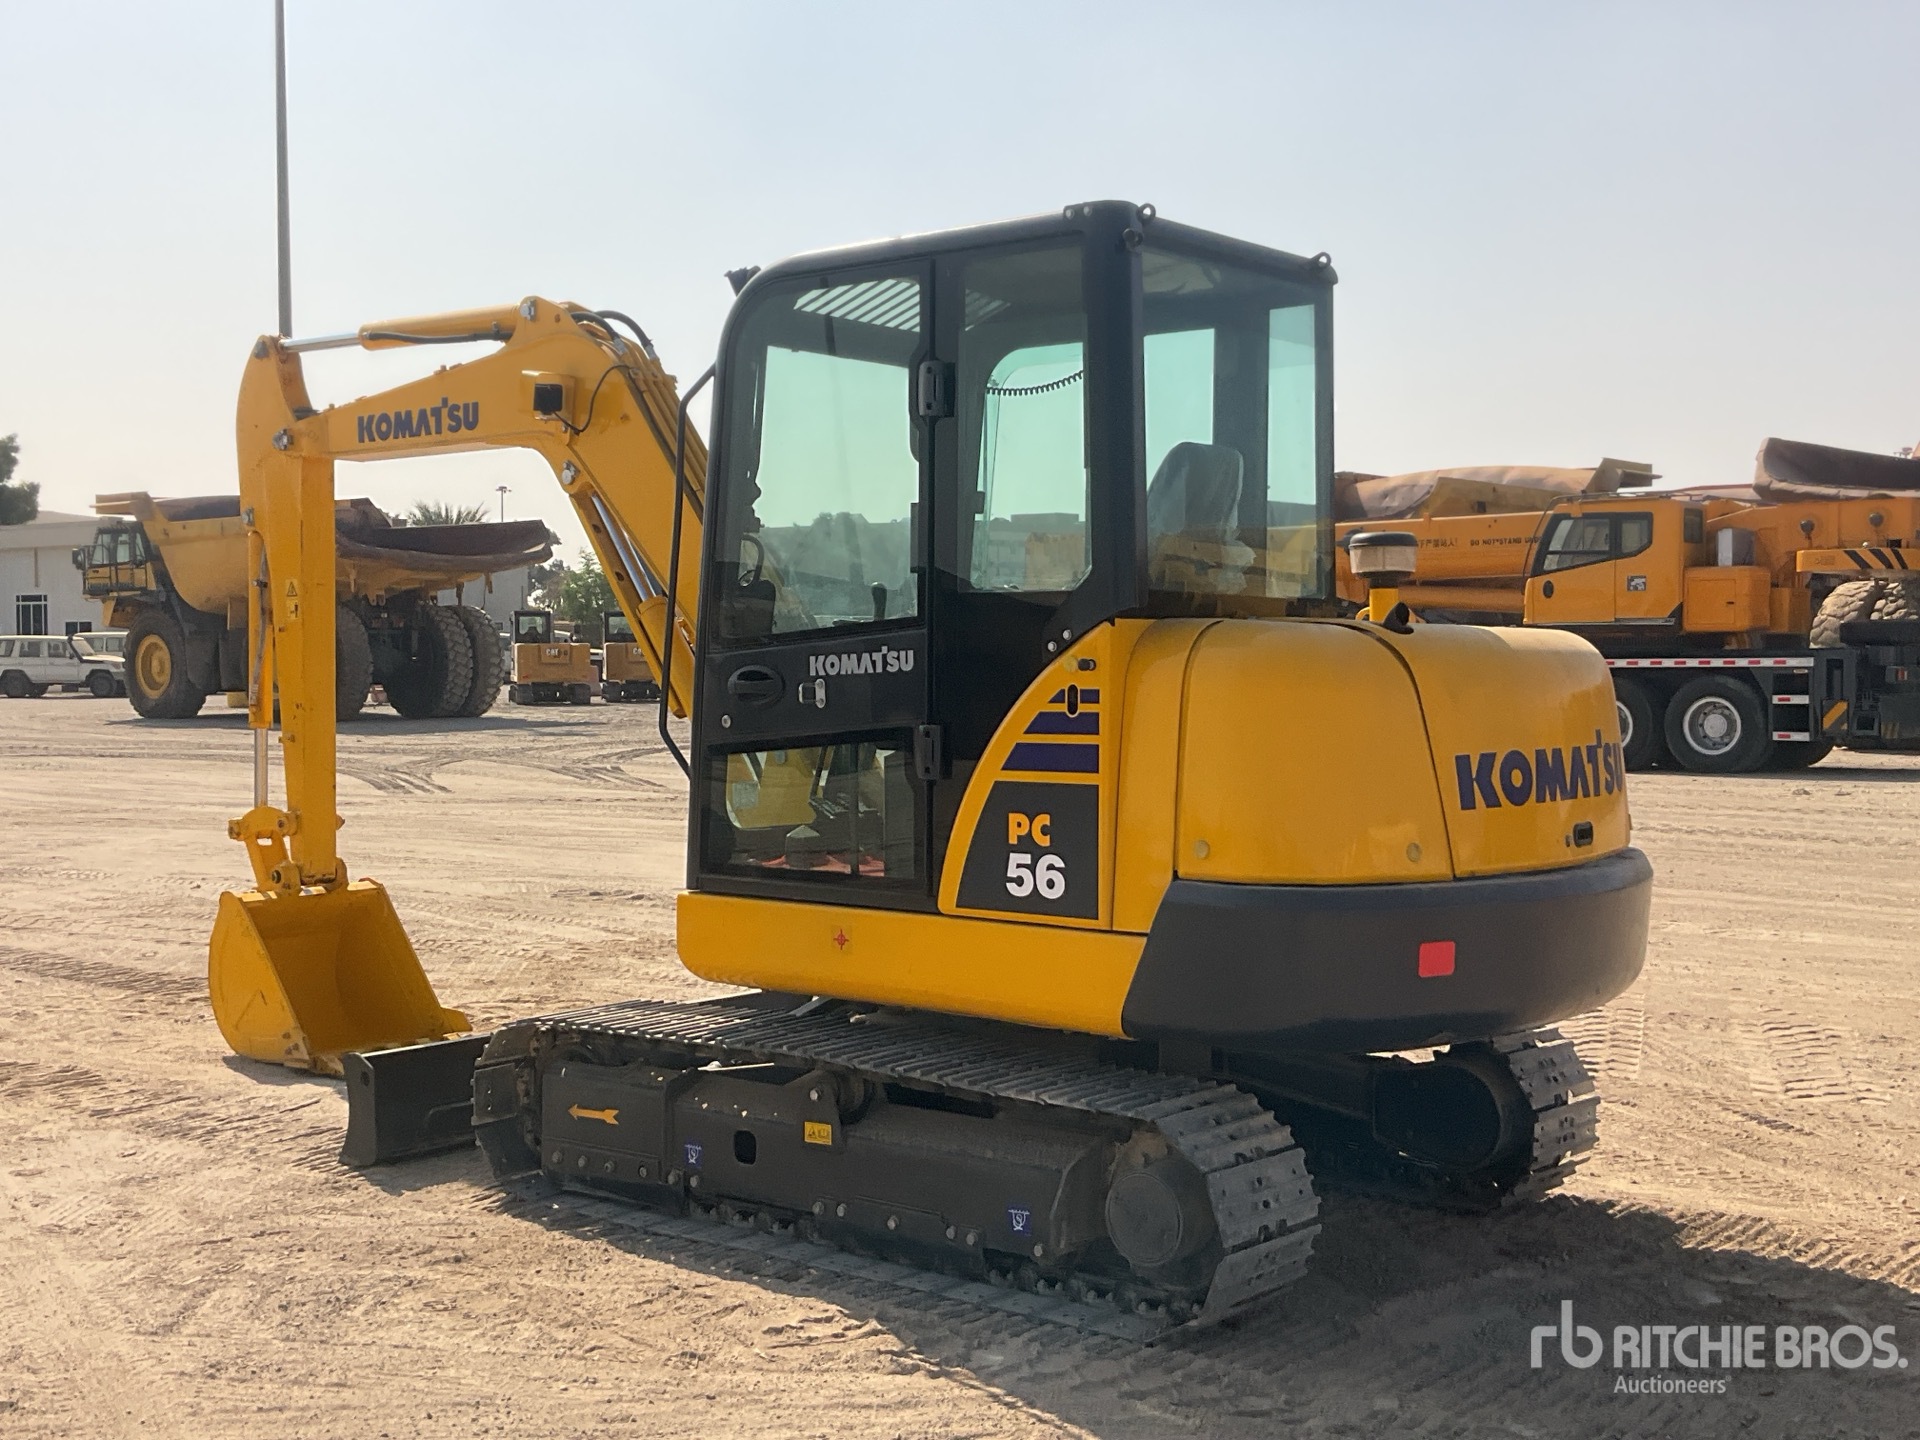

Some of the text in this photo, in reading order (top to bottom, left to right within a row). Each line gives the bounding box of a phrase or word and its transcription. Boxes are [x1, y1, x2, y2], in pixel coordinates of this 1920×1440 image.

[357, 397, 479, 444] KOMATSU
[546, 648, 559, 656] CAT
[809, 645, 915, 677] KOMATSU
[1455, 729, 1623, 811] KOMATSU
[1008, 812, 1051, 847] PC
[1005, 852, 1066, 900] 56
